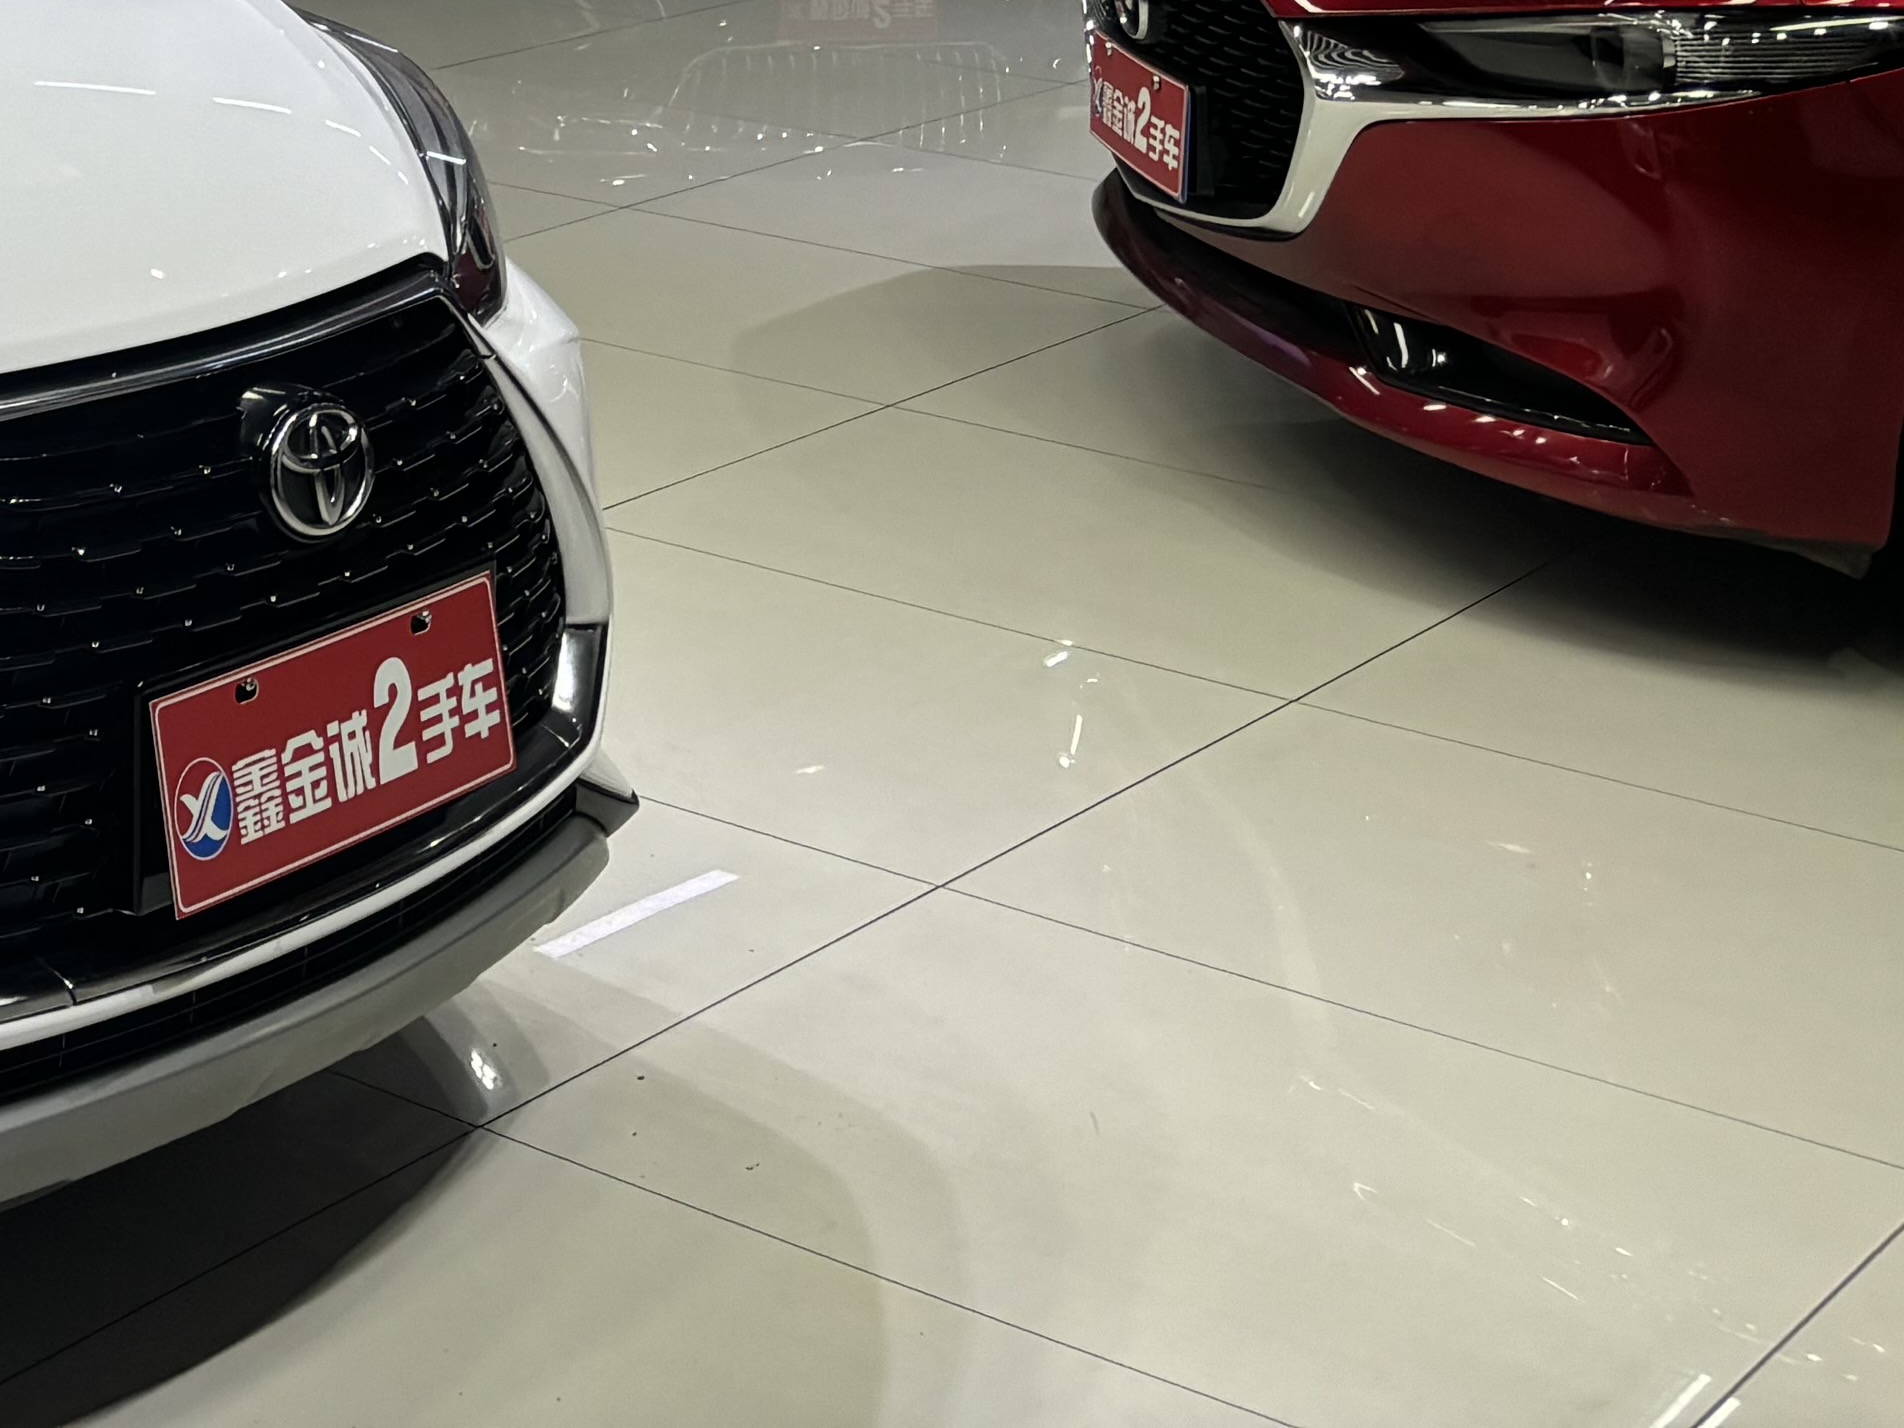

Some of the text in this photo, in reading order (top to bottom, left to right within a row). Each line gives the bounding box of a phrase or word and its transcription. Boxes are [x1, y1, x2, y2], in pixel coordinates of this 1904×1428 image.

[1102, 86, 1180, 170] 鑫金诚2手车
[232, 657, 500, 846] 鑫金诚2手车
